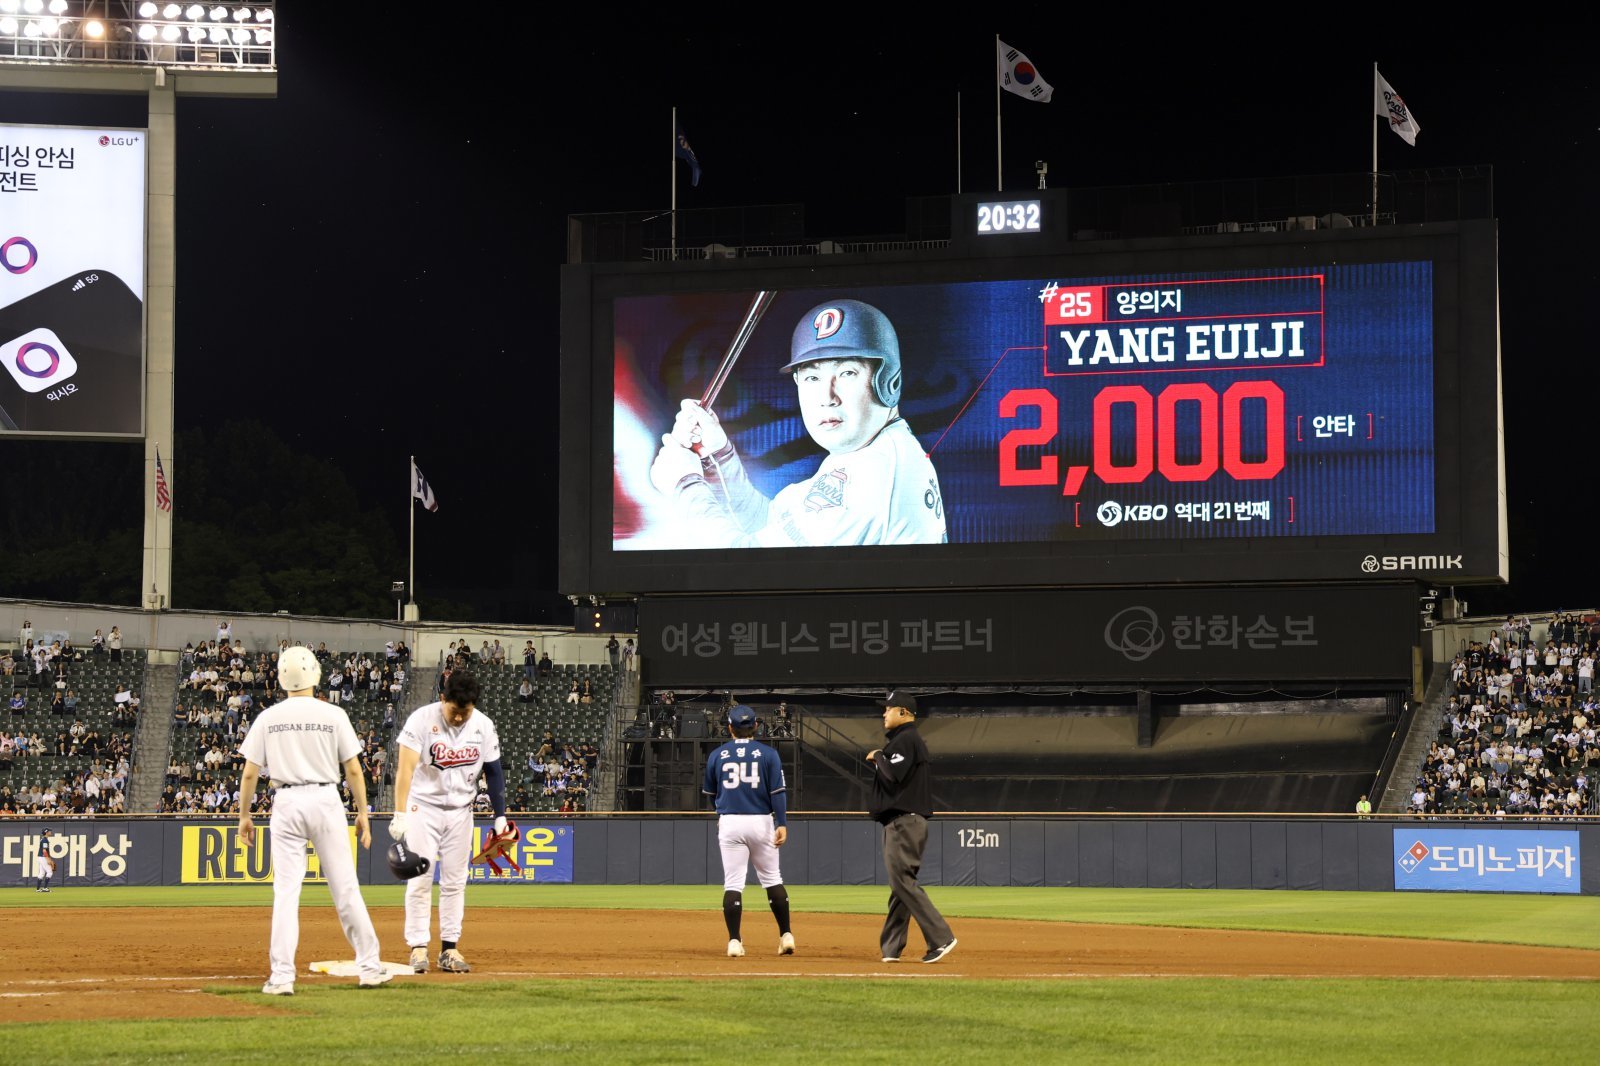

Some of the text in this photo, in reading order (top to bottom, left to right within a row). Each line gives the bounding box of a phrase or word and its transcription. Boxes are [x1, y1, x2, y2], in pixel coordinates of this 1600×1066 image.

[35, 146, 74, 169] 안심
[0, 171, 38, 193] 전트
[978, 204, 1040, 231] 20:32
[85, 273, 99, 284] 5G
[1116, 289, 1182, 315] 양의지
[1060, 320, 1305, 365] YANG EUIJI
[46, 383, 79, 401] 익시오
[999, 380, 1357, 496] 2,000 안타
[1124, 501, 1270, 522] KBO 역대 21 번째
[1382, 555, 1463, 570] SAMIK
[661, 618, 993, 657] 여성 웰니스 리딩 파트너
[1171, 615, 1318, 651] 한화손보
[268, 723, 334, 734] DOOSAN BEARS
[432, 742, 481, 764] Bears
[722, 762, 760, 789] 34
[957, 828, 999, 848] 125m
[3, 833, 133, 877] 대해상
[1428, 845, 1576, 878] 도미노피자
